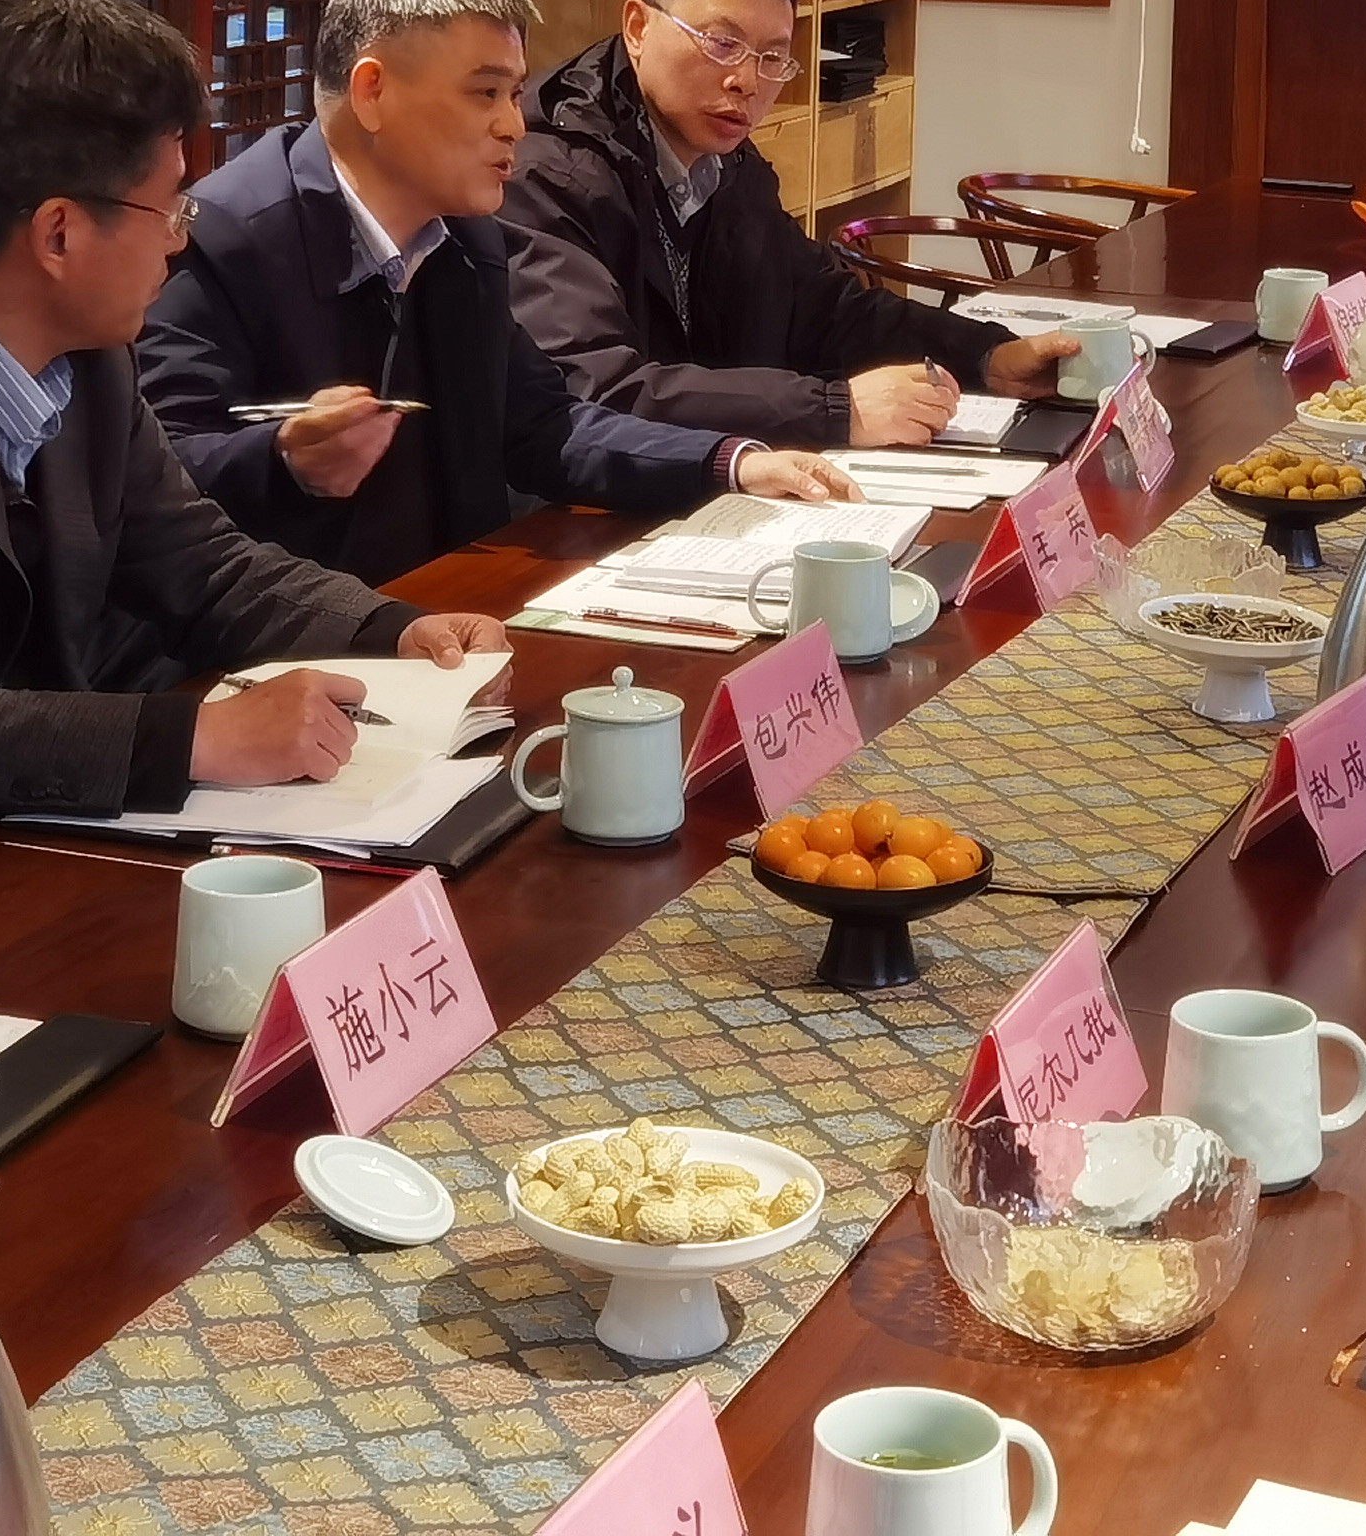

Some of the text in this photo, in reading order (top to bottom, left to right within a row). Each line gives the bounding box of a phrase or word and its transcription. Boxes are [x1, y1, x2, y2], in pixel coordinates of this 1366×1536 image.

[754, 672, 840, 760] 包兴伟
[325, 936, 459, 1082] 施小云
